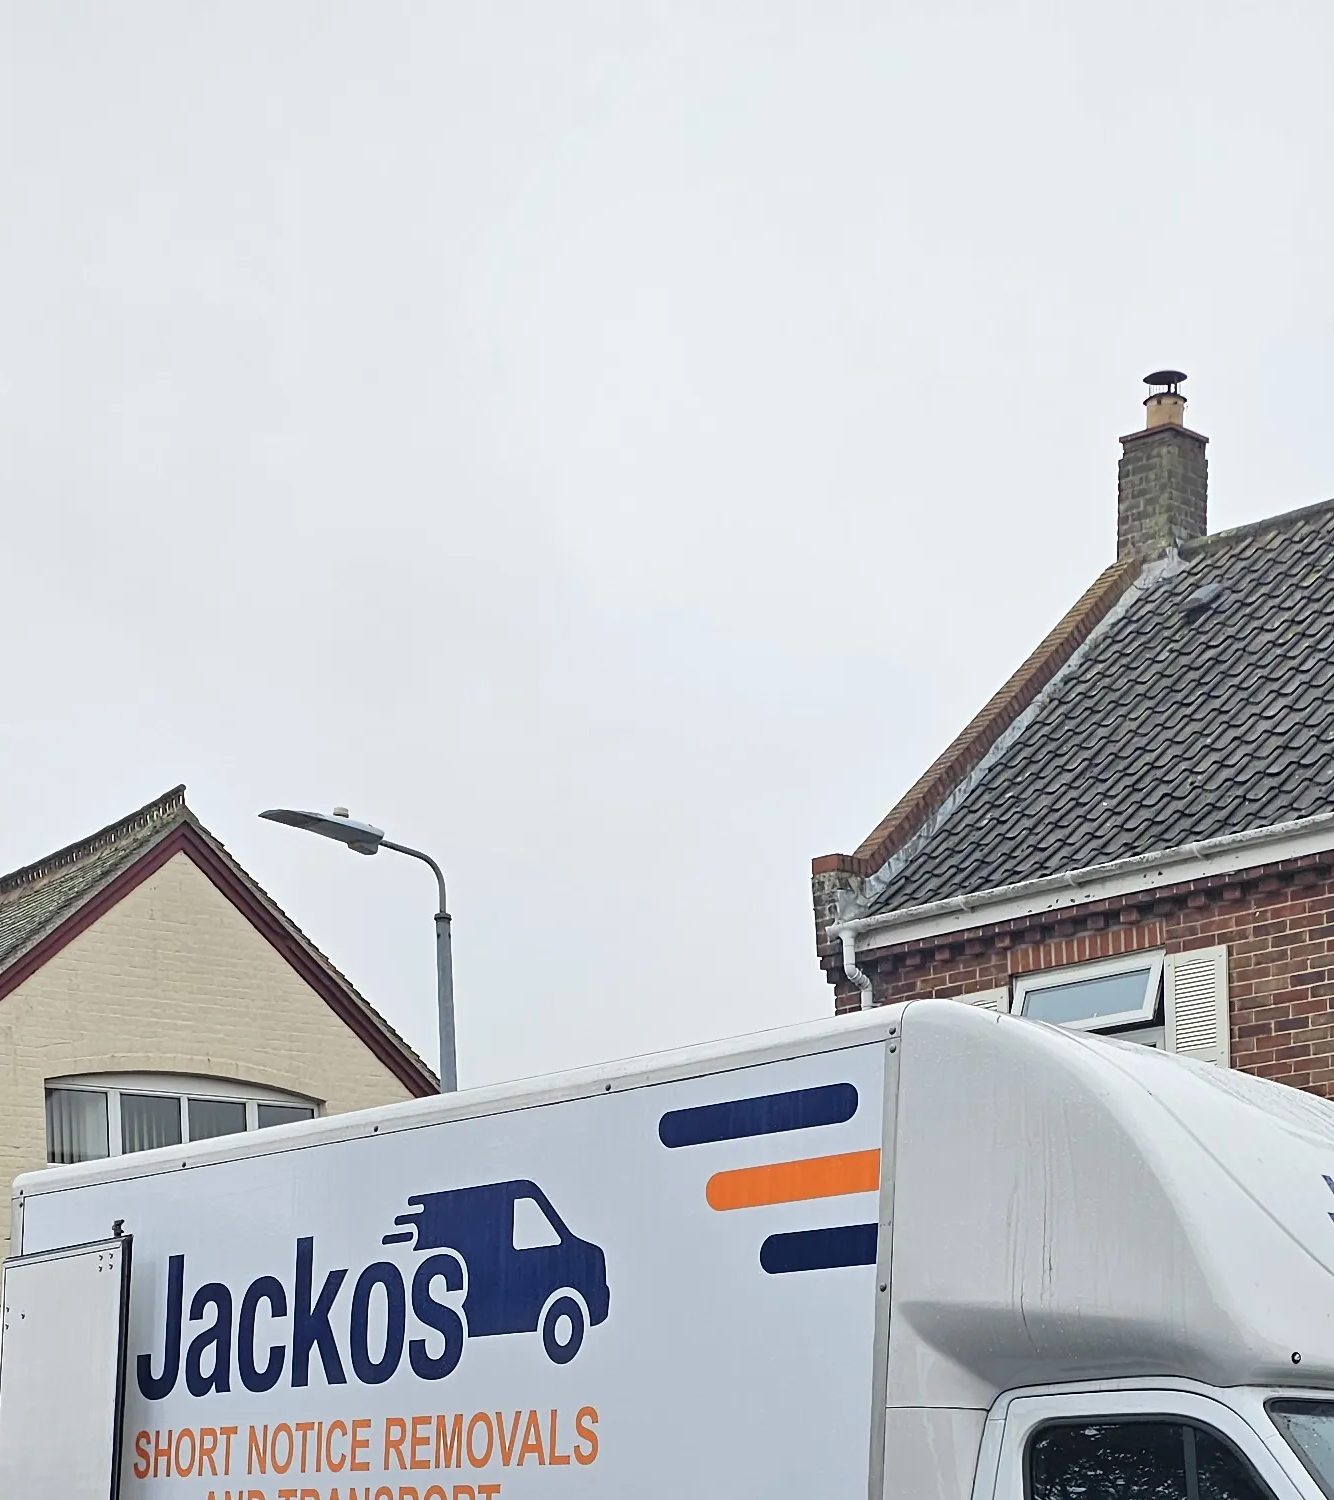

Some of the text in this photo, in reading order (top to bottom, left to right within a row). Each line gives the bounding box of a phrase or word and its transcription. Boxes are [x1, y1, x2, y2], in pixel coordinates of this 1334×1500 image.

[136, 1236, 464, 1401] Jackos
[133, 1406, 600, 1479] SHORT NOTICE REMOVALS
